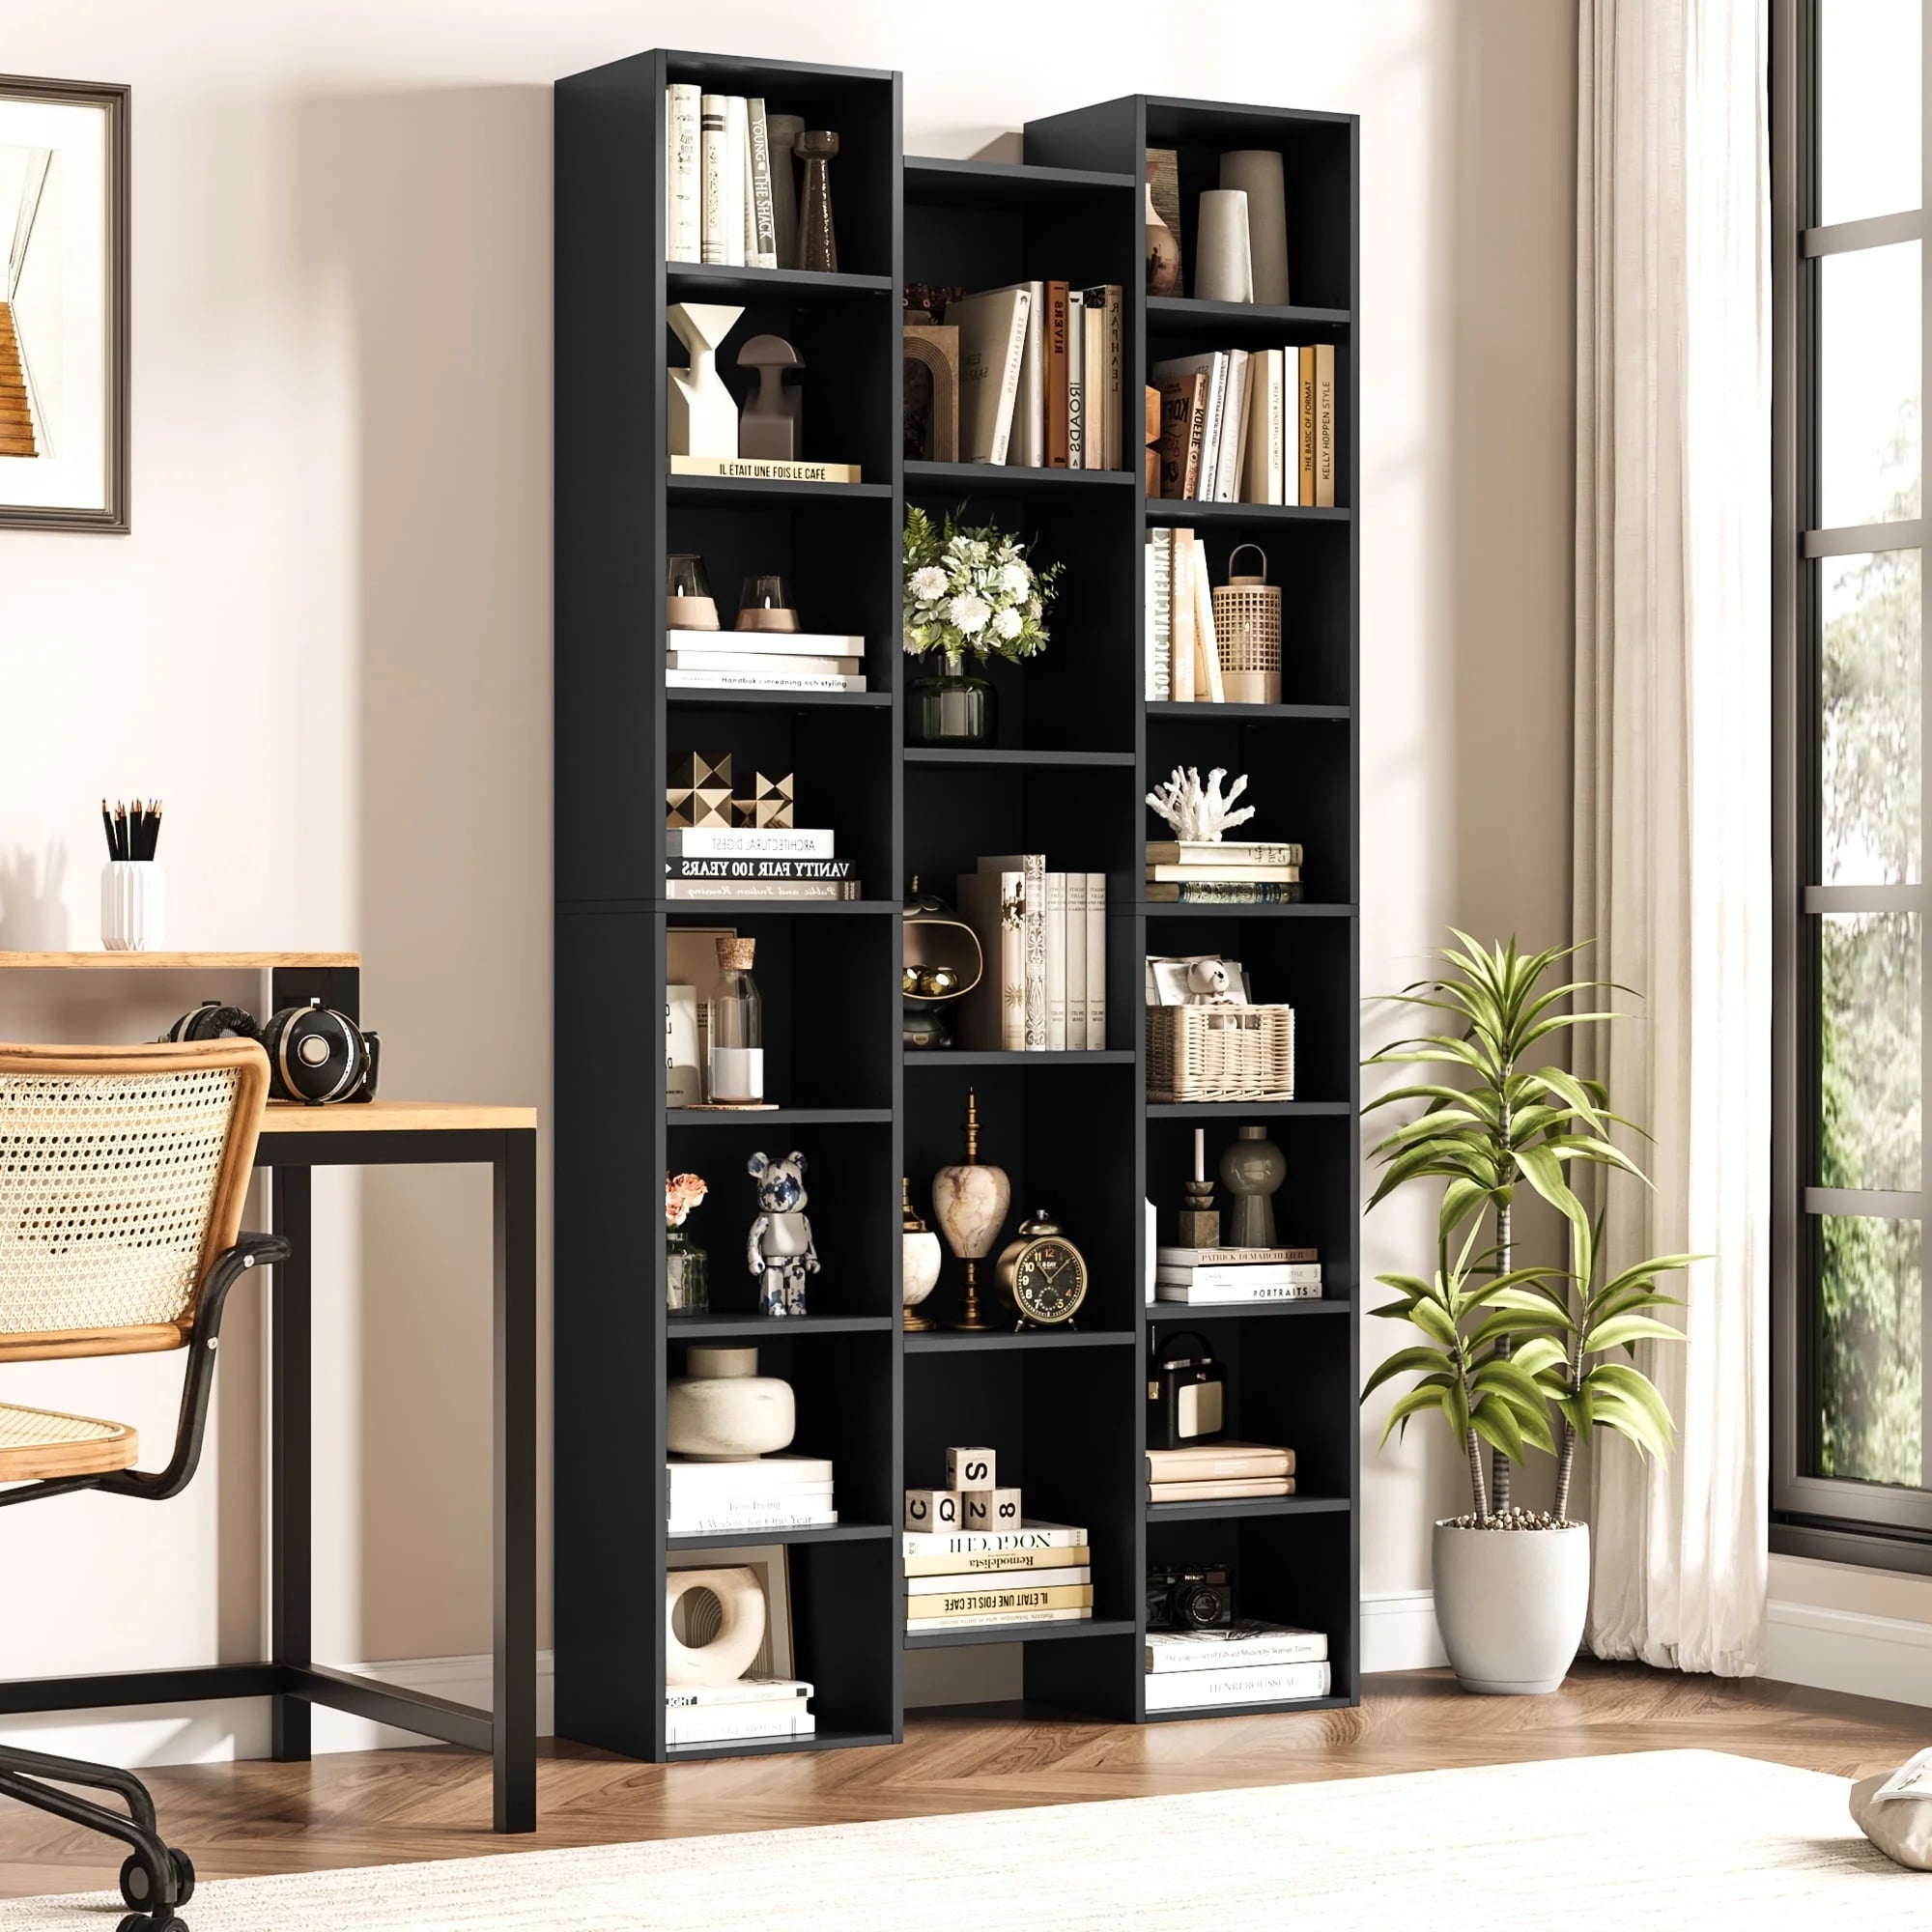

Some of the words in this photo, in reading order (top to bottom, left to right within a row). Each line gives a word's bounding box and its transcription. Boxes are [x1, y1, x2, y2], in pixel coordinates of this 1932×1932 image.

[752, 118, 767, 167] YOUNG
[753, 173, 769, 197] THE
[756, 197, 774, 240] SHACK
[1321, 381, 1330, 410] STYLE
[1304, 415, 1312, 429] OF
[1321, 412, 1330, 449] HOPPEN
[720, 463, 727, 475] IL
[729, 462, 752, 477] ÉTAIT
[754, 465, 771, 477] UNE
[773, 467, 791, 478] FOIS
[794, 468, 803, 479] LE
[805, 466, 826, 480] CAFÉ
[1321, 451, 1330, 480] KELLY
[1153, 536, 1170, 636] ПАСТЕРНАК
[1153, 639, 1170, 696] БОРИС
[821, 679, 847, 689] styling
[1034, 1252, 1042, 1262] 11
[1045, 1248, 1055, 1258] 12
[1025, 1262, 1035, 1272] 10
[1022, 1275, 1030, 1286] 9
[1025, 1289, 1033, 1299] 8
[1253, 1286, 1308, 1297] PORTRAITS
[1034, 1298, 1040, 1309] 7
[1057, 1298, 1065, 1309] 5
[965, 1462, 987, 1481] S
[910, 1499, 926, 1520] C
[940, 1498, 956, 1522] Q
[970, 1502, 986, 1519] 2
[999, 1502, 1016, 1519] 8
[790, 1515, 812, 1524] Year
[950, 1532, 1051, 1553] NOGUCHI
[969, 1555, 1035, 1569] Remodelista
[967, 1598, 977, 1609] LE
[979, 1596, 996, 1608] FOIS
[998, 1595, 1014, 1606] UNE
[1017, 1593, 1038, 1607] ÉTAIT
[1041, 1592, 1048, 1605] IL
[944, 1599, 965, 1613] CAFÉ
